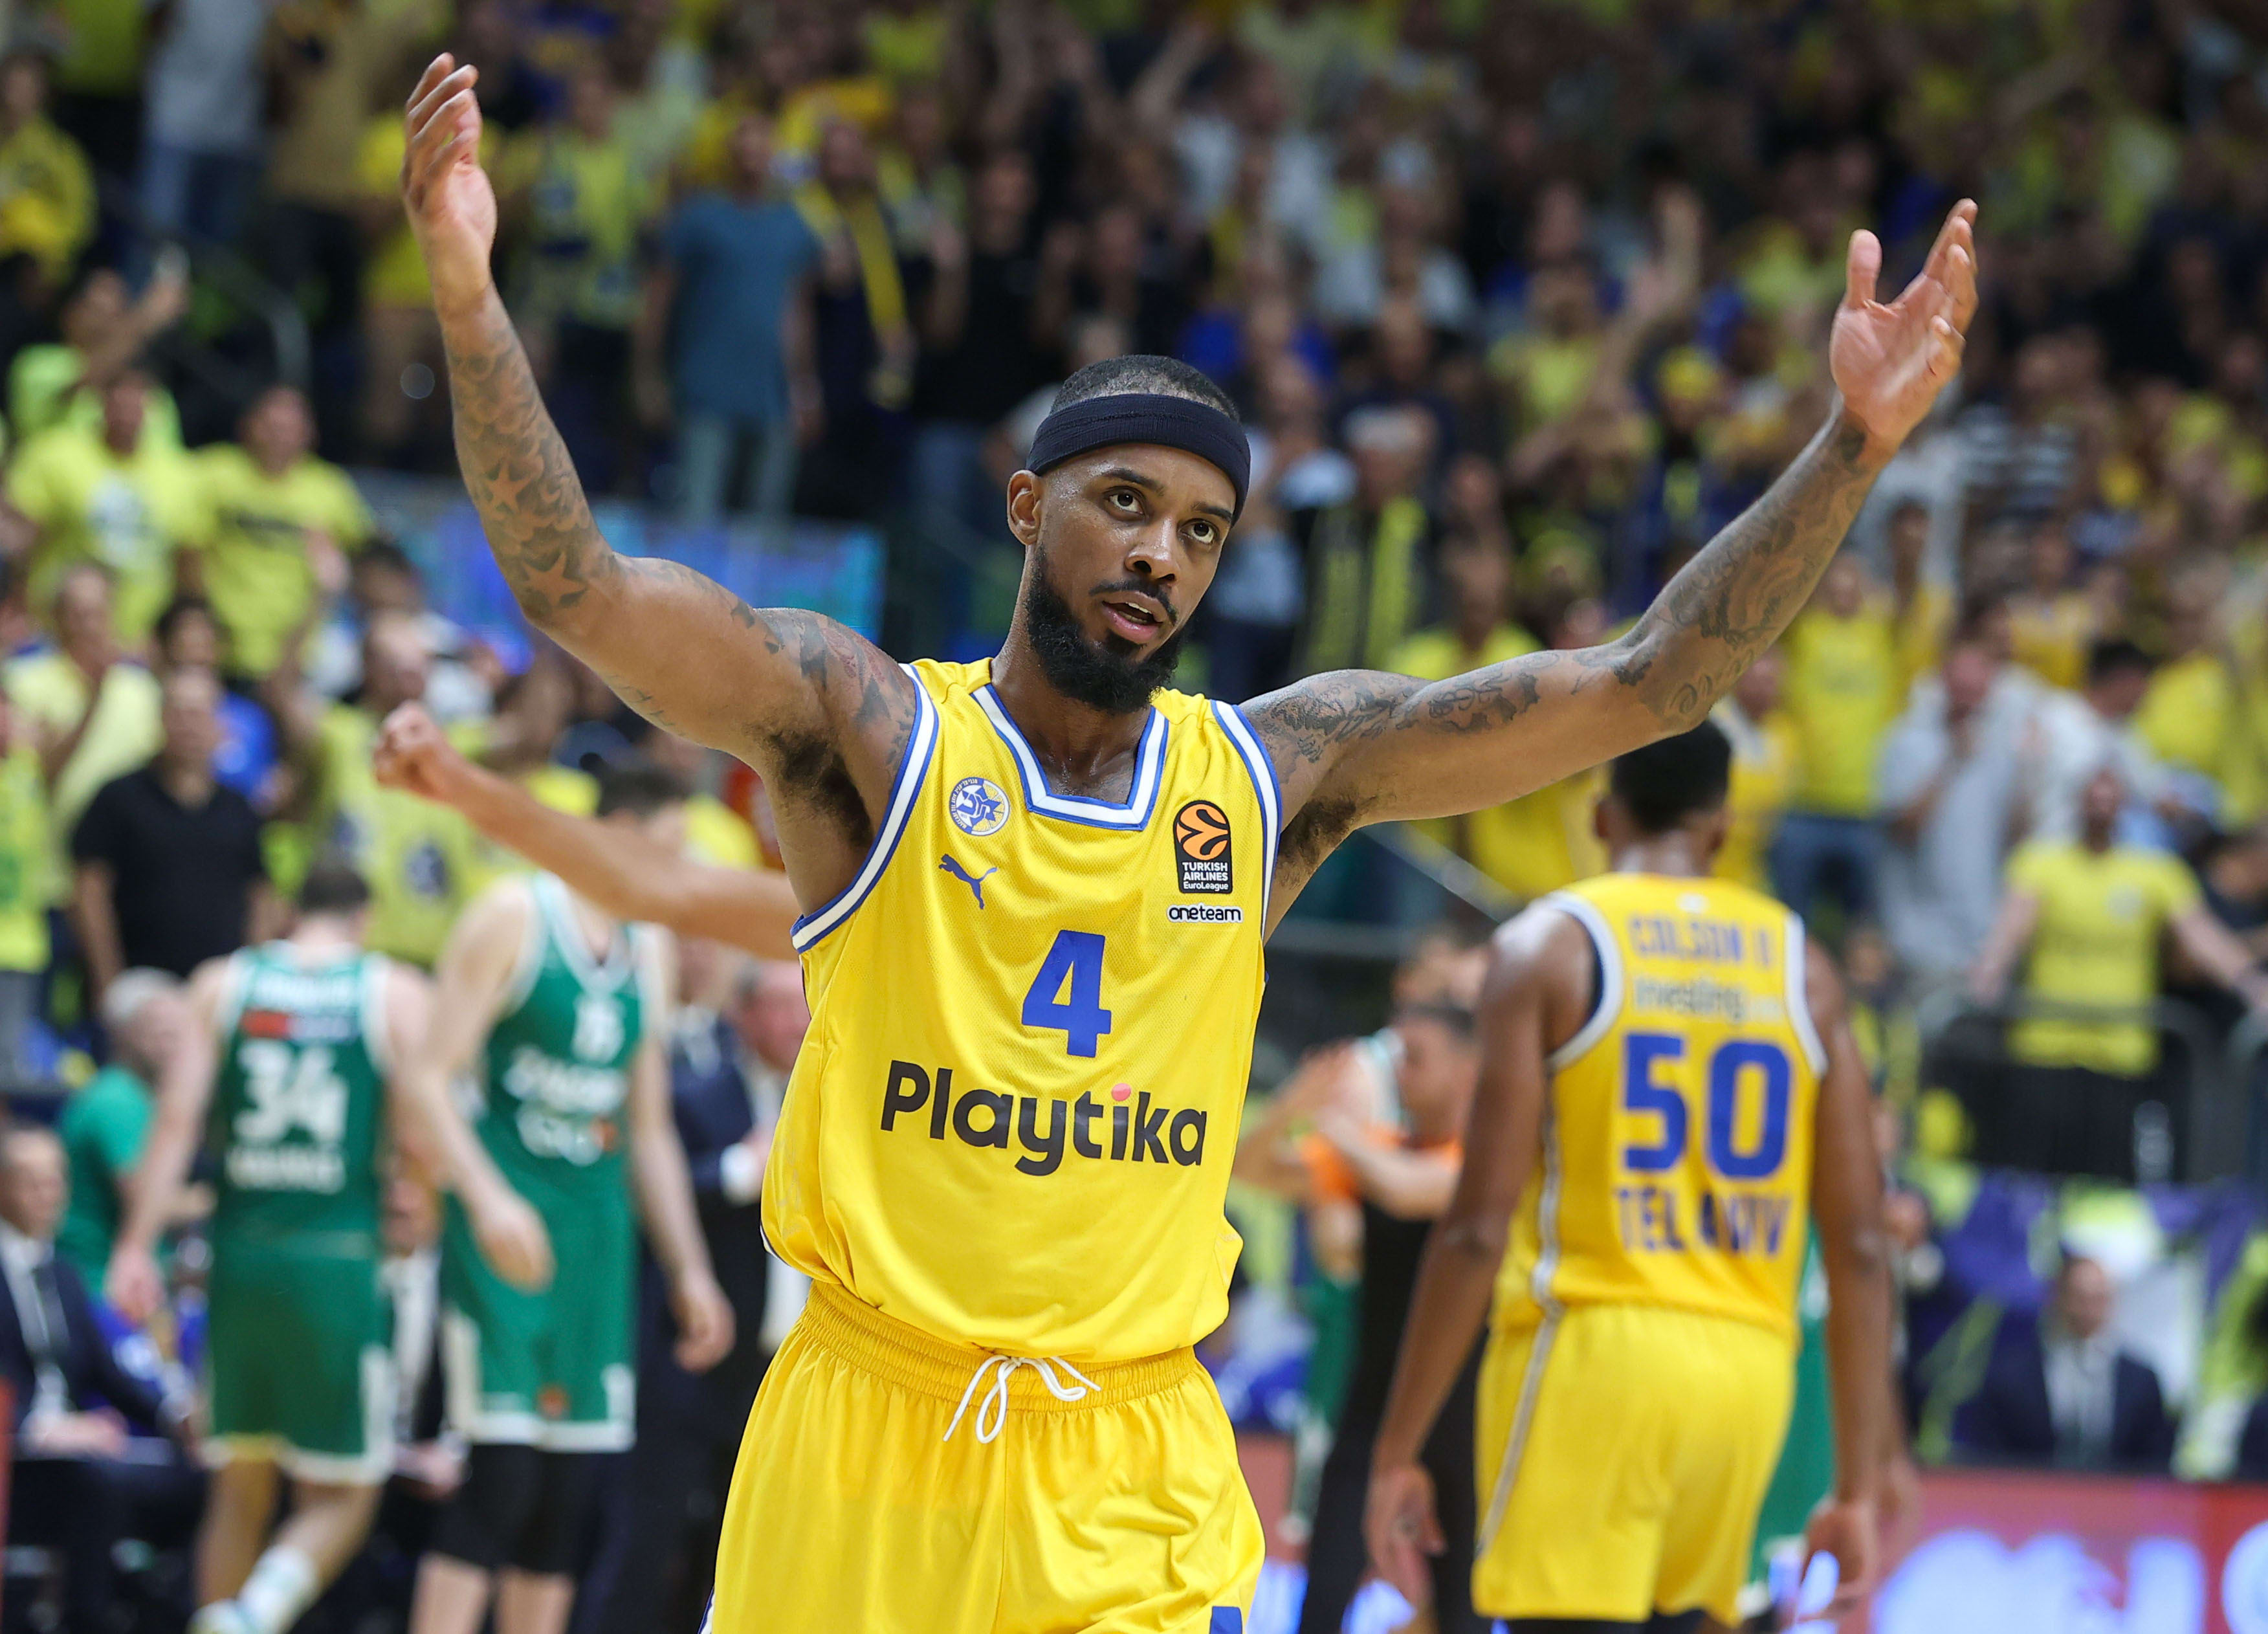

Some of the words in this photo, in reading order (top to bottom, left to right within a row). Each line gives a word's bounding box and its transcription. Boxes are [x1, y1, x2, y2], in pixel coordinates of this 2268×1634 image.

[1182, 862, 1228, 871] TURKISH
[1183, 872, 1228, 881] AIRLINES
[1183, 881, 1229, 892] EuroLeague
[1169, 905, 1242, 921] oneteam
[1021, 929, 1112, 1058] 4
[234, 1040, 349, 1142] 34
[880, 1059, 1207, 1176] Playtika
[1625, 1033, 1790, 1178] 50
